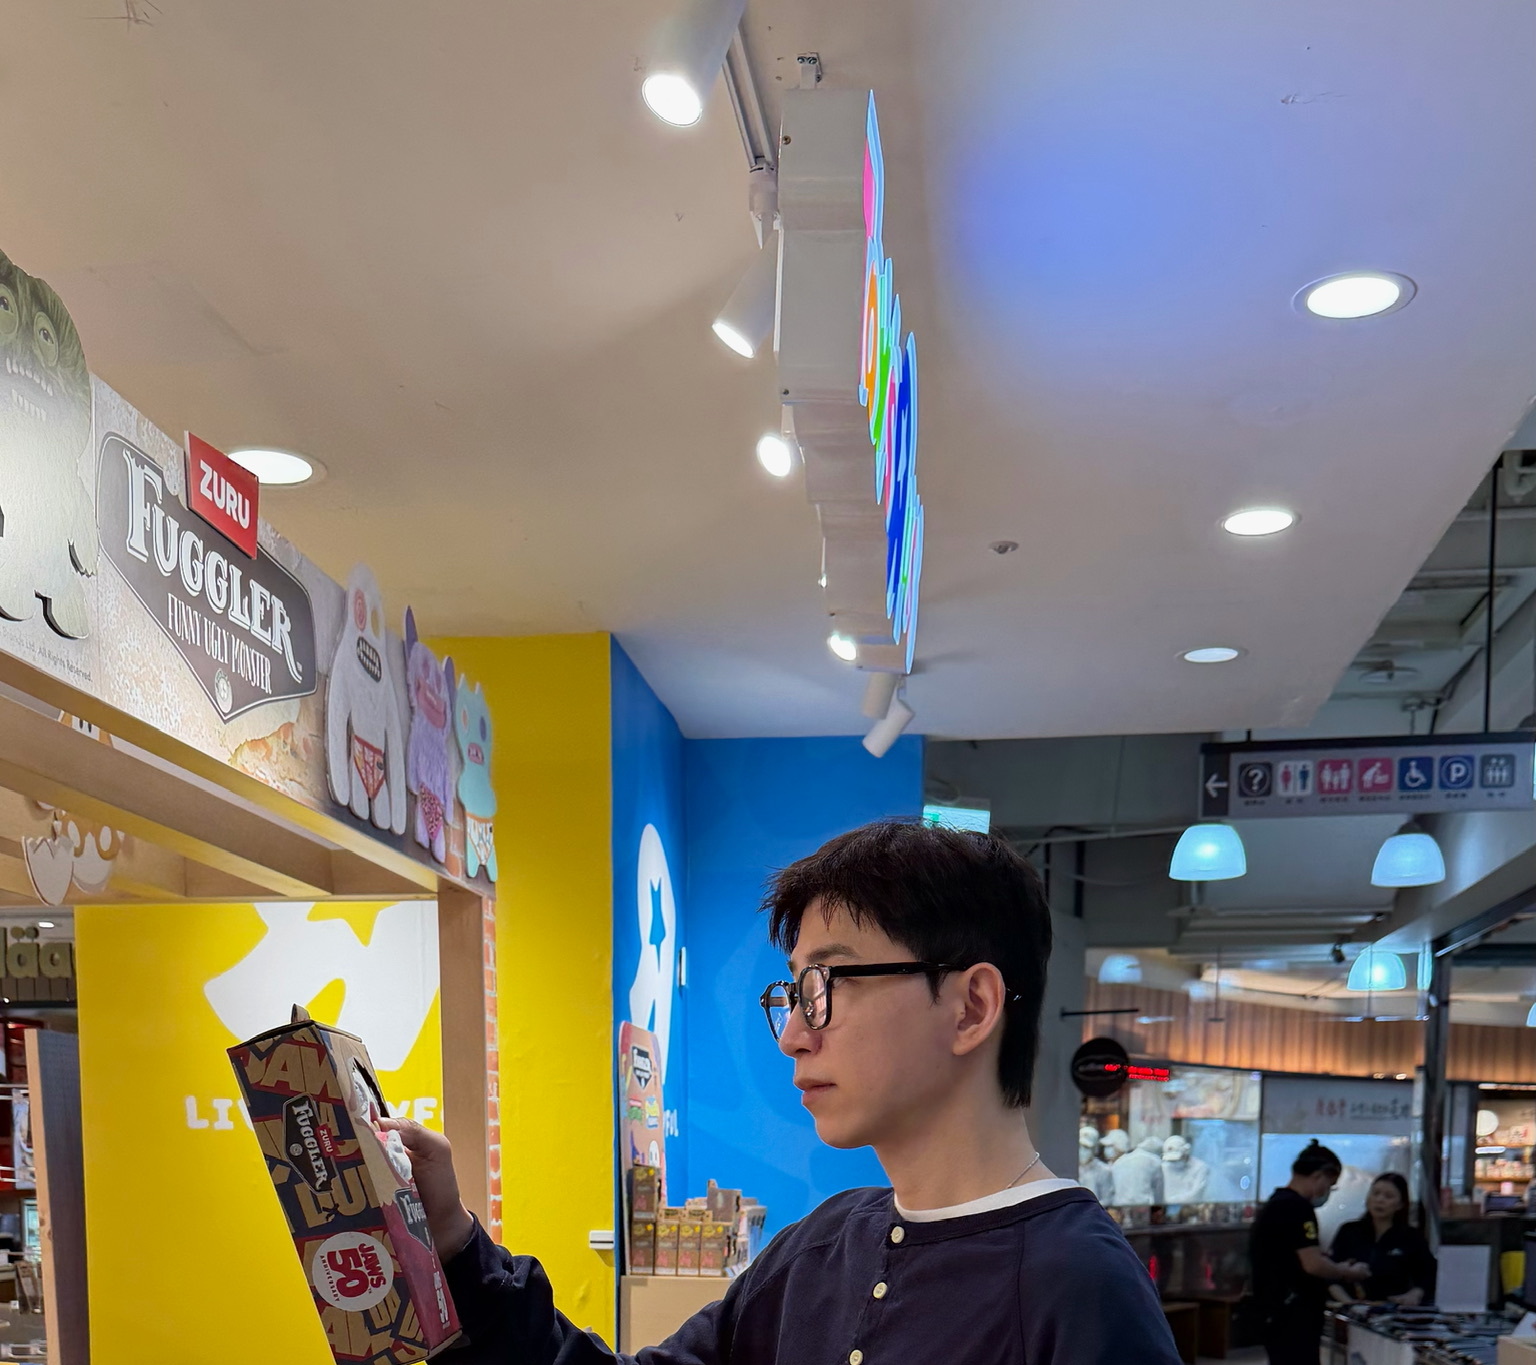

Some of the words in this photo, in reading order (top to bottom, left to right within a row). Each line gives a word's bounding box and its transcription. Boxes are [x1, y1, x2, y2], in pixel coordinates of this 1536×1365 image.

[200, 459, 250, 530] ZURU
[122, 449, 303, 684] FUGGLER
[167, 592, 202, 648] FUNNY
[203, 614, 231, 665] UGLY
[231, 635, 273, 695] MONSTER
[291, 1100, 329, 1191] FUGGLER
[318, 1129, 334, 1153] ZURU
[327, 1248, 370, 1298] 50
[358, 1242, 388, 1289] JAWS
